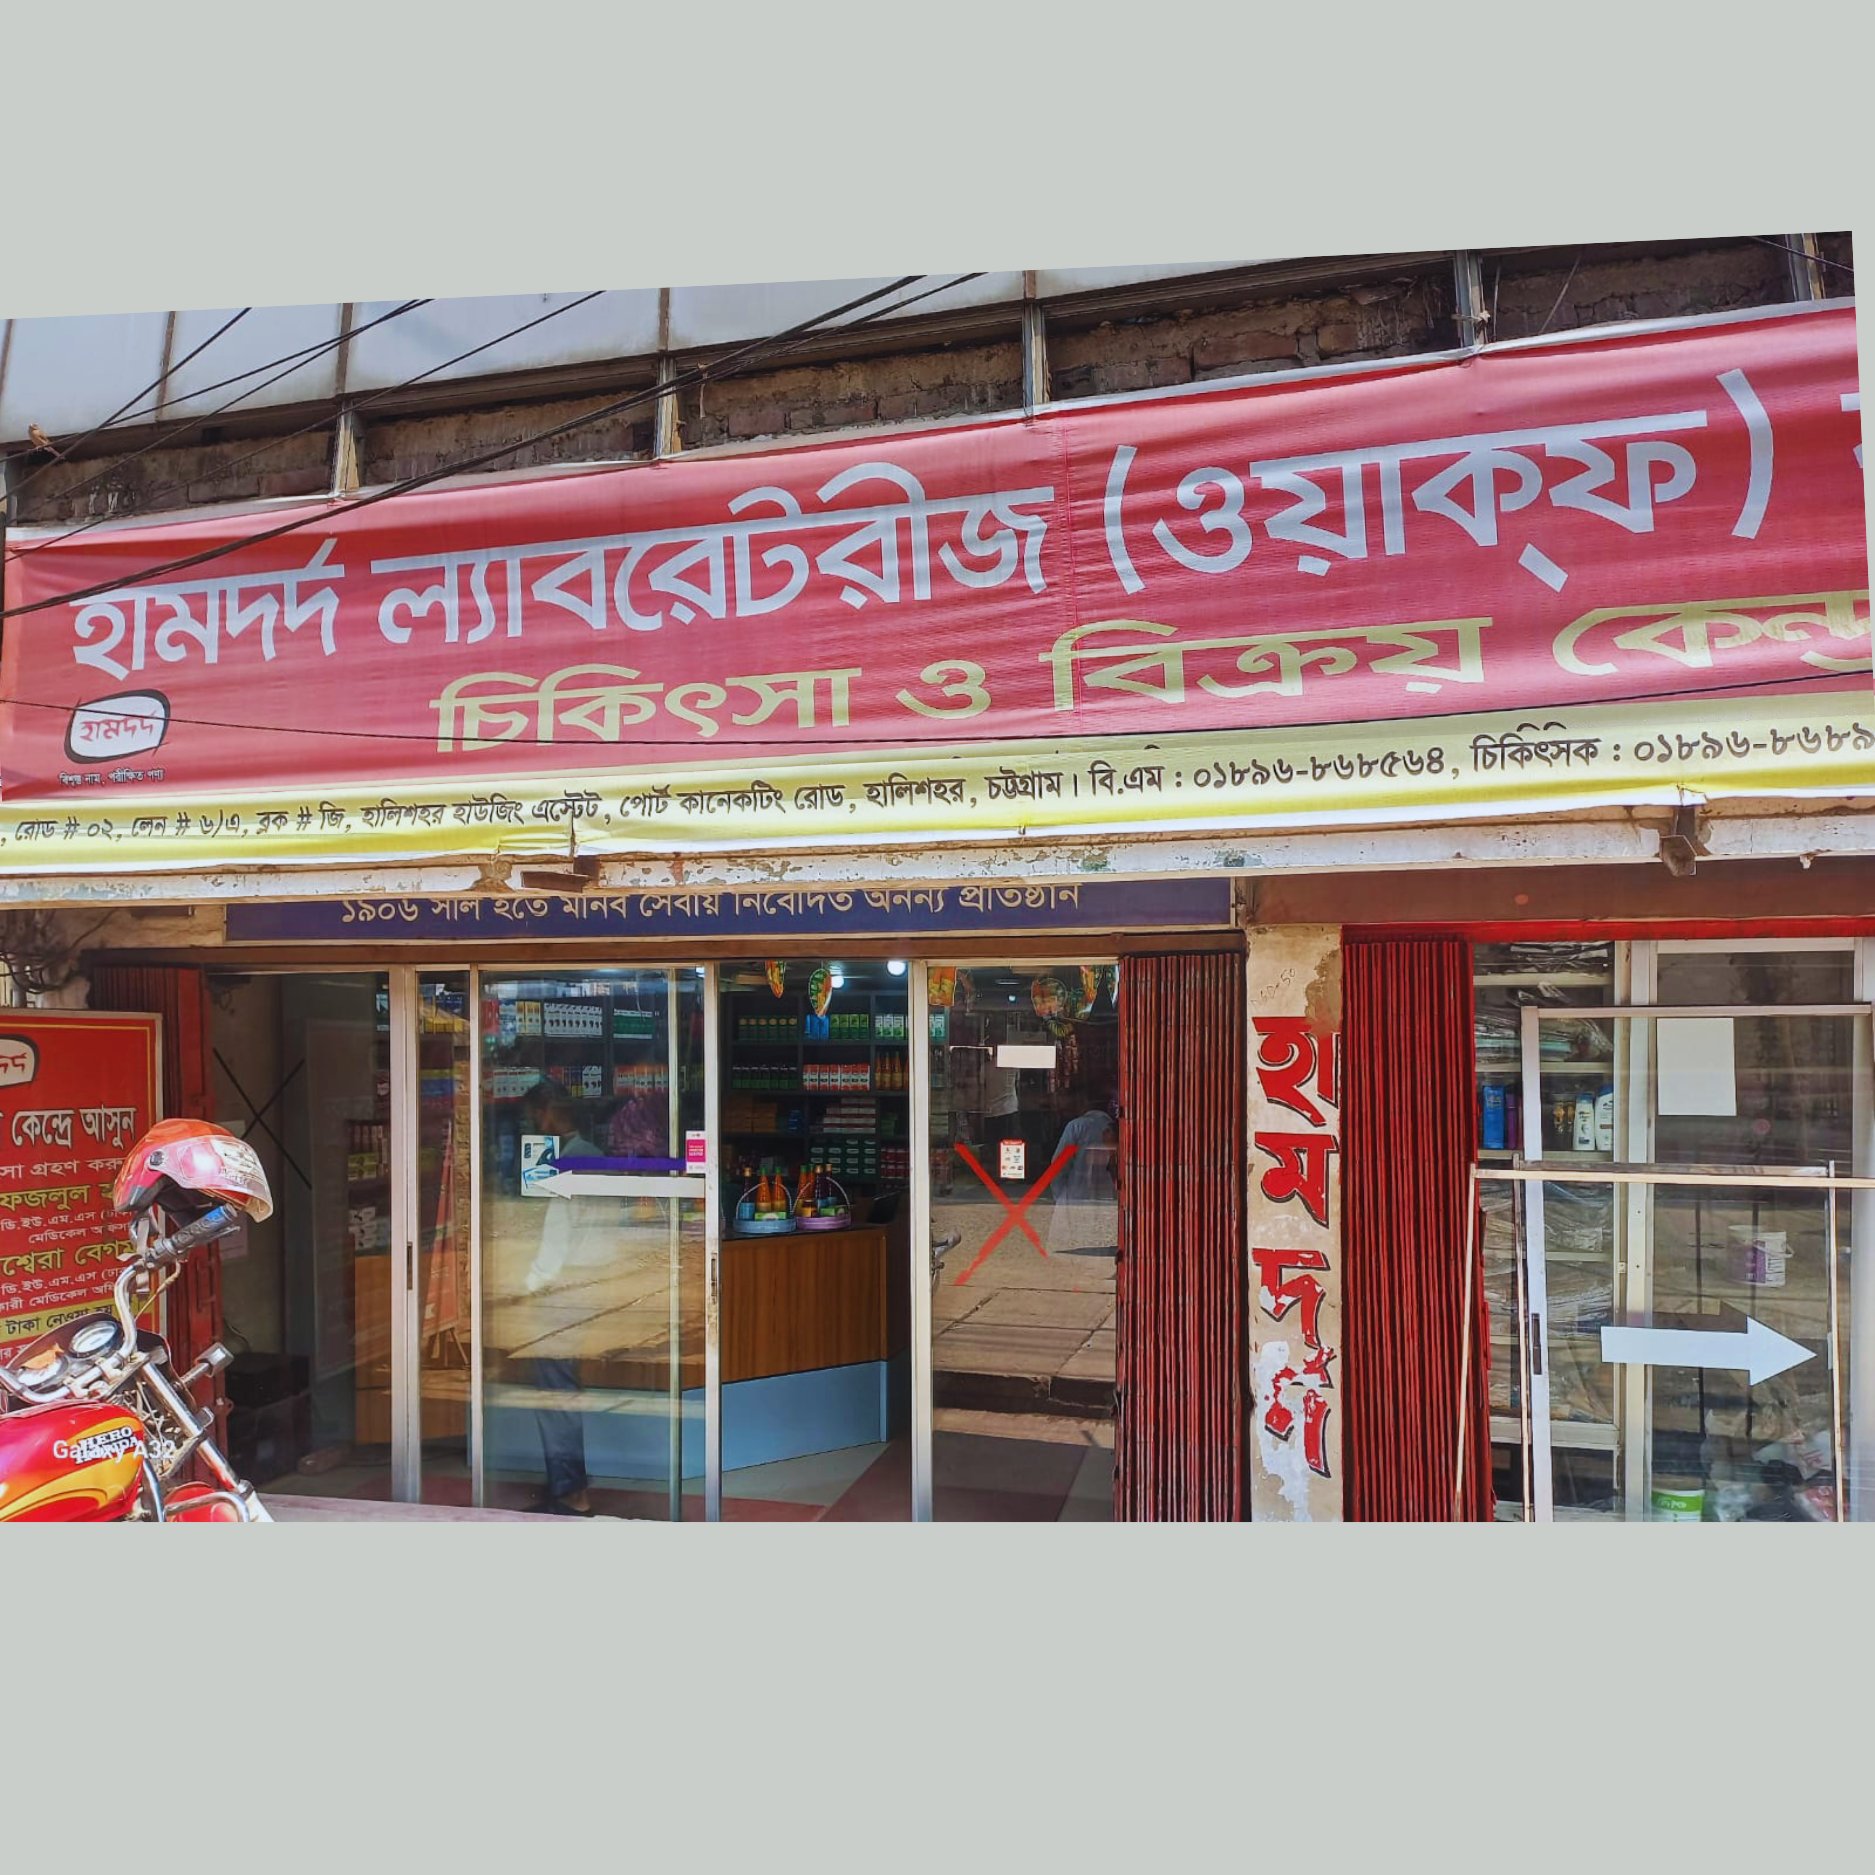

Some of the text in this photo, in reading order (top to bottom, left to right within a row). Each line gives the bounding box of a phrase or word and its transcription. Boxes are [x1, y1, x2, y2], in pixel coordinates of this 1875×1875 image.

[70, 537, 345, 682] হামদর্দ
[370, 462, 1054, 644] ল্যাবরেটরীজ
[79, 709, 157, 742] হামদর্দ
[429, 662, 862, 753] চিকিৎসা
[896, 659, 992, 719] ও
[1038, 617, 1492, 712] বিক্রয়
[15, 818, 58, 841] রোড
[87, 818, 123, 842] ০২,
[131, 816, 168, 838] লেন
[318, 801, 351, 833] জি,
[360, 797, 447, 828] হালিশহর
[452, 792, 526, 826] হাউজিং
[620, 784, 672, 817] পোর্ট
[676, 780, 786, 814] কানেকটিং
[794, 784, 856, 813] রোড,
[863, 772, 977, 808] হালিশহর,
[1470, 732, 1602, 772] চিকিৎসক
[1633, 721, 1875, 763] ০১৮৯৬-৮৬৮৯
[12, 1103, 137, 1149] কেন্দ্রে আসুন
